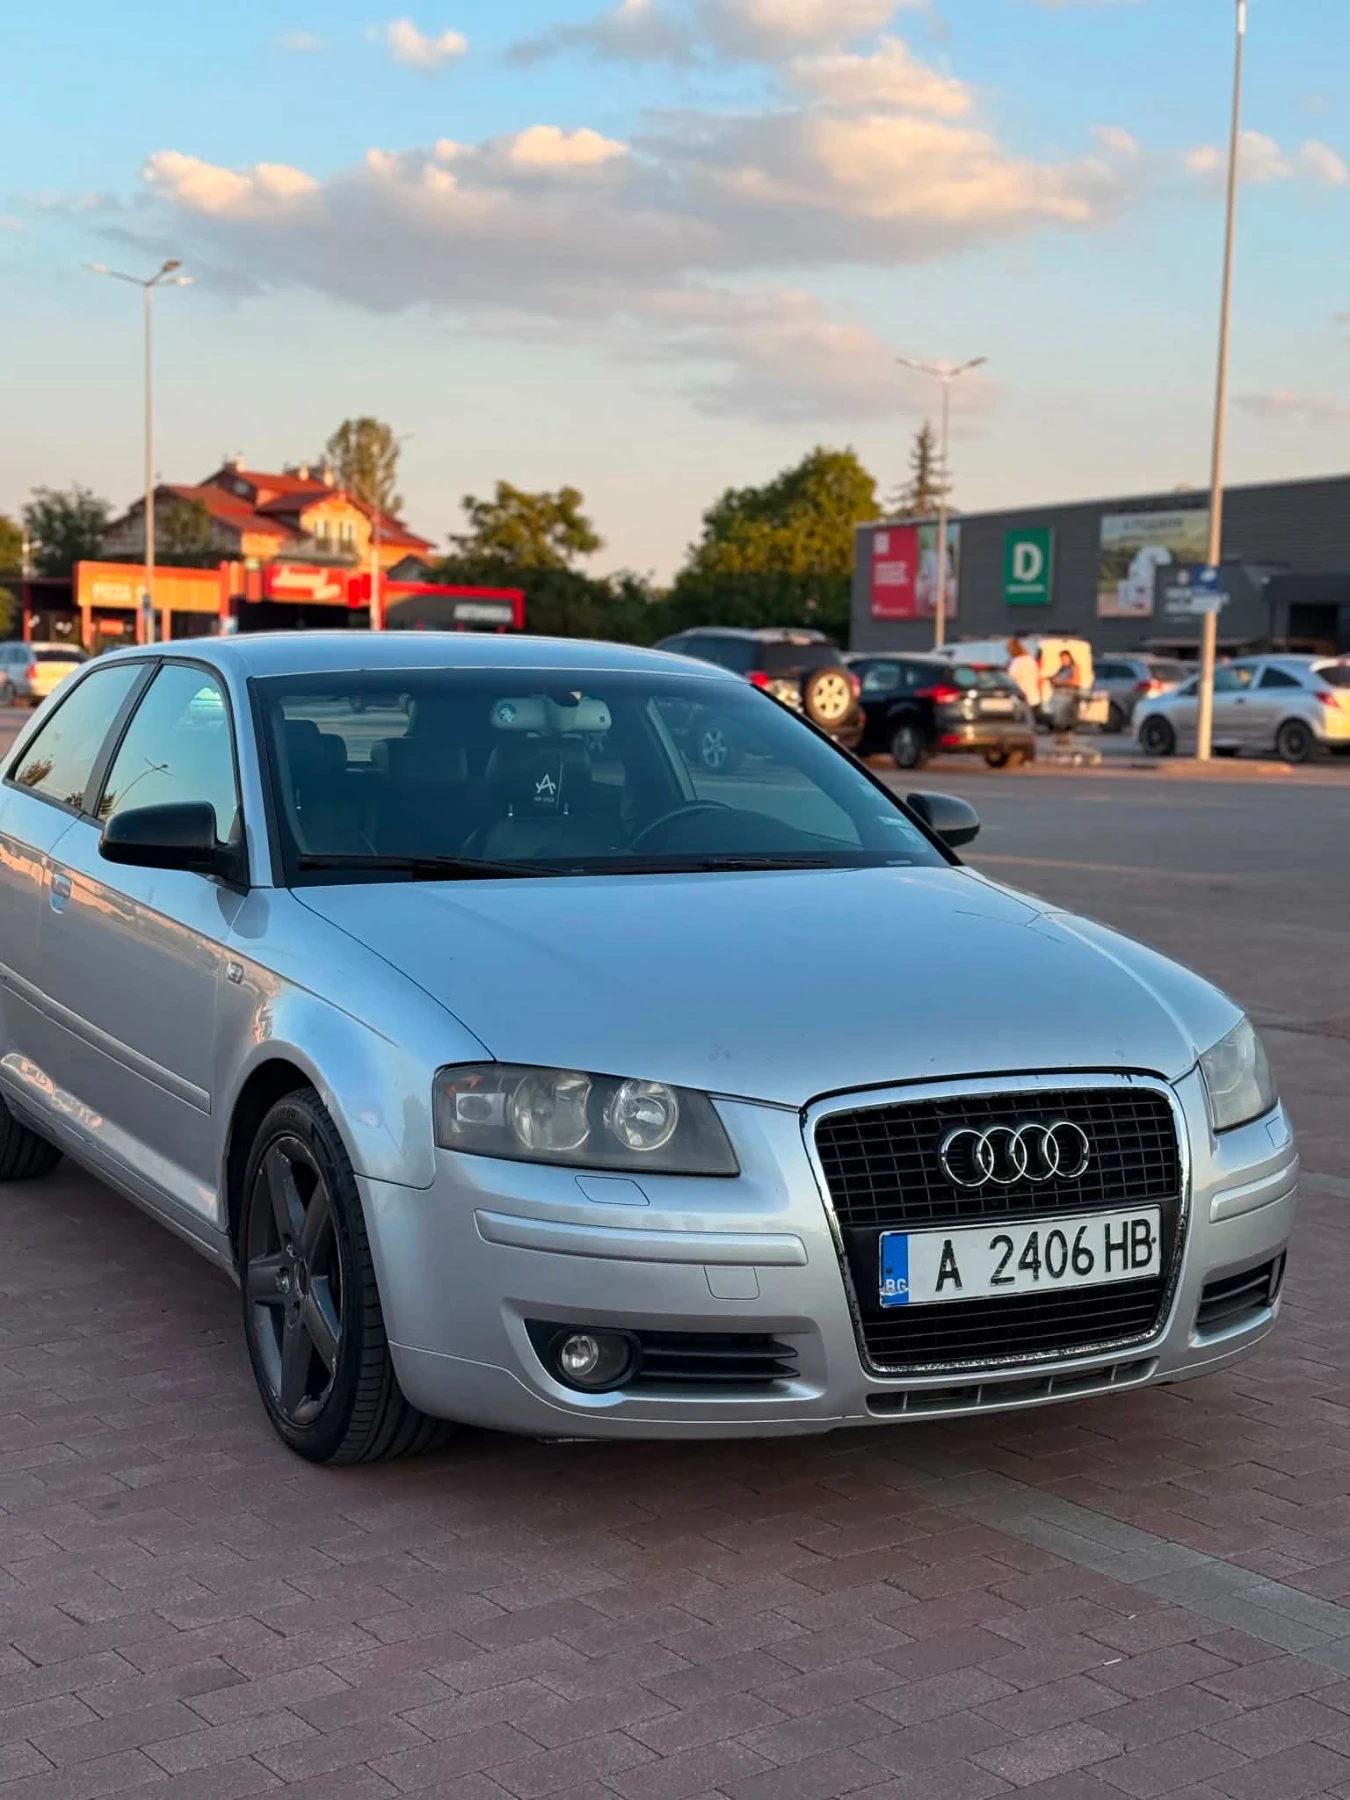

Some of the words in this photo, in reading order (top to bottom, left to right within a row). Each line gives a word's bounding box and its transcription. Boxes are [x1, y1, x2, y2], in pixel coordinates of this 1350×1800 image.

[935, 1239, 963, 1293] A
[989, 1225, 1095, 1287] 2406
[1104, 1218, 1153, 1273] HB
[885, 1278, 907, 1294] BG
